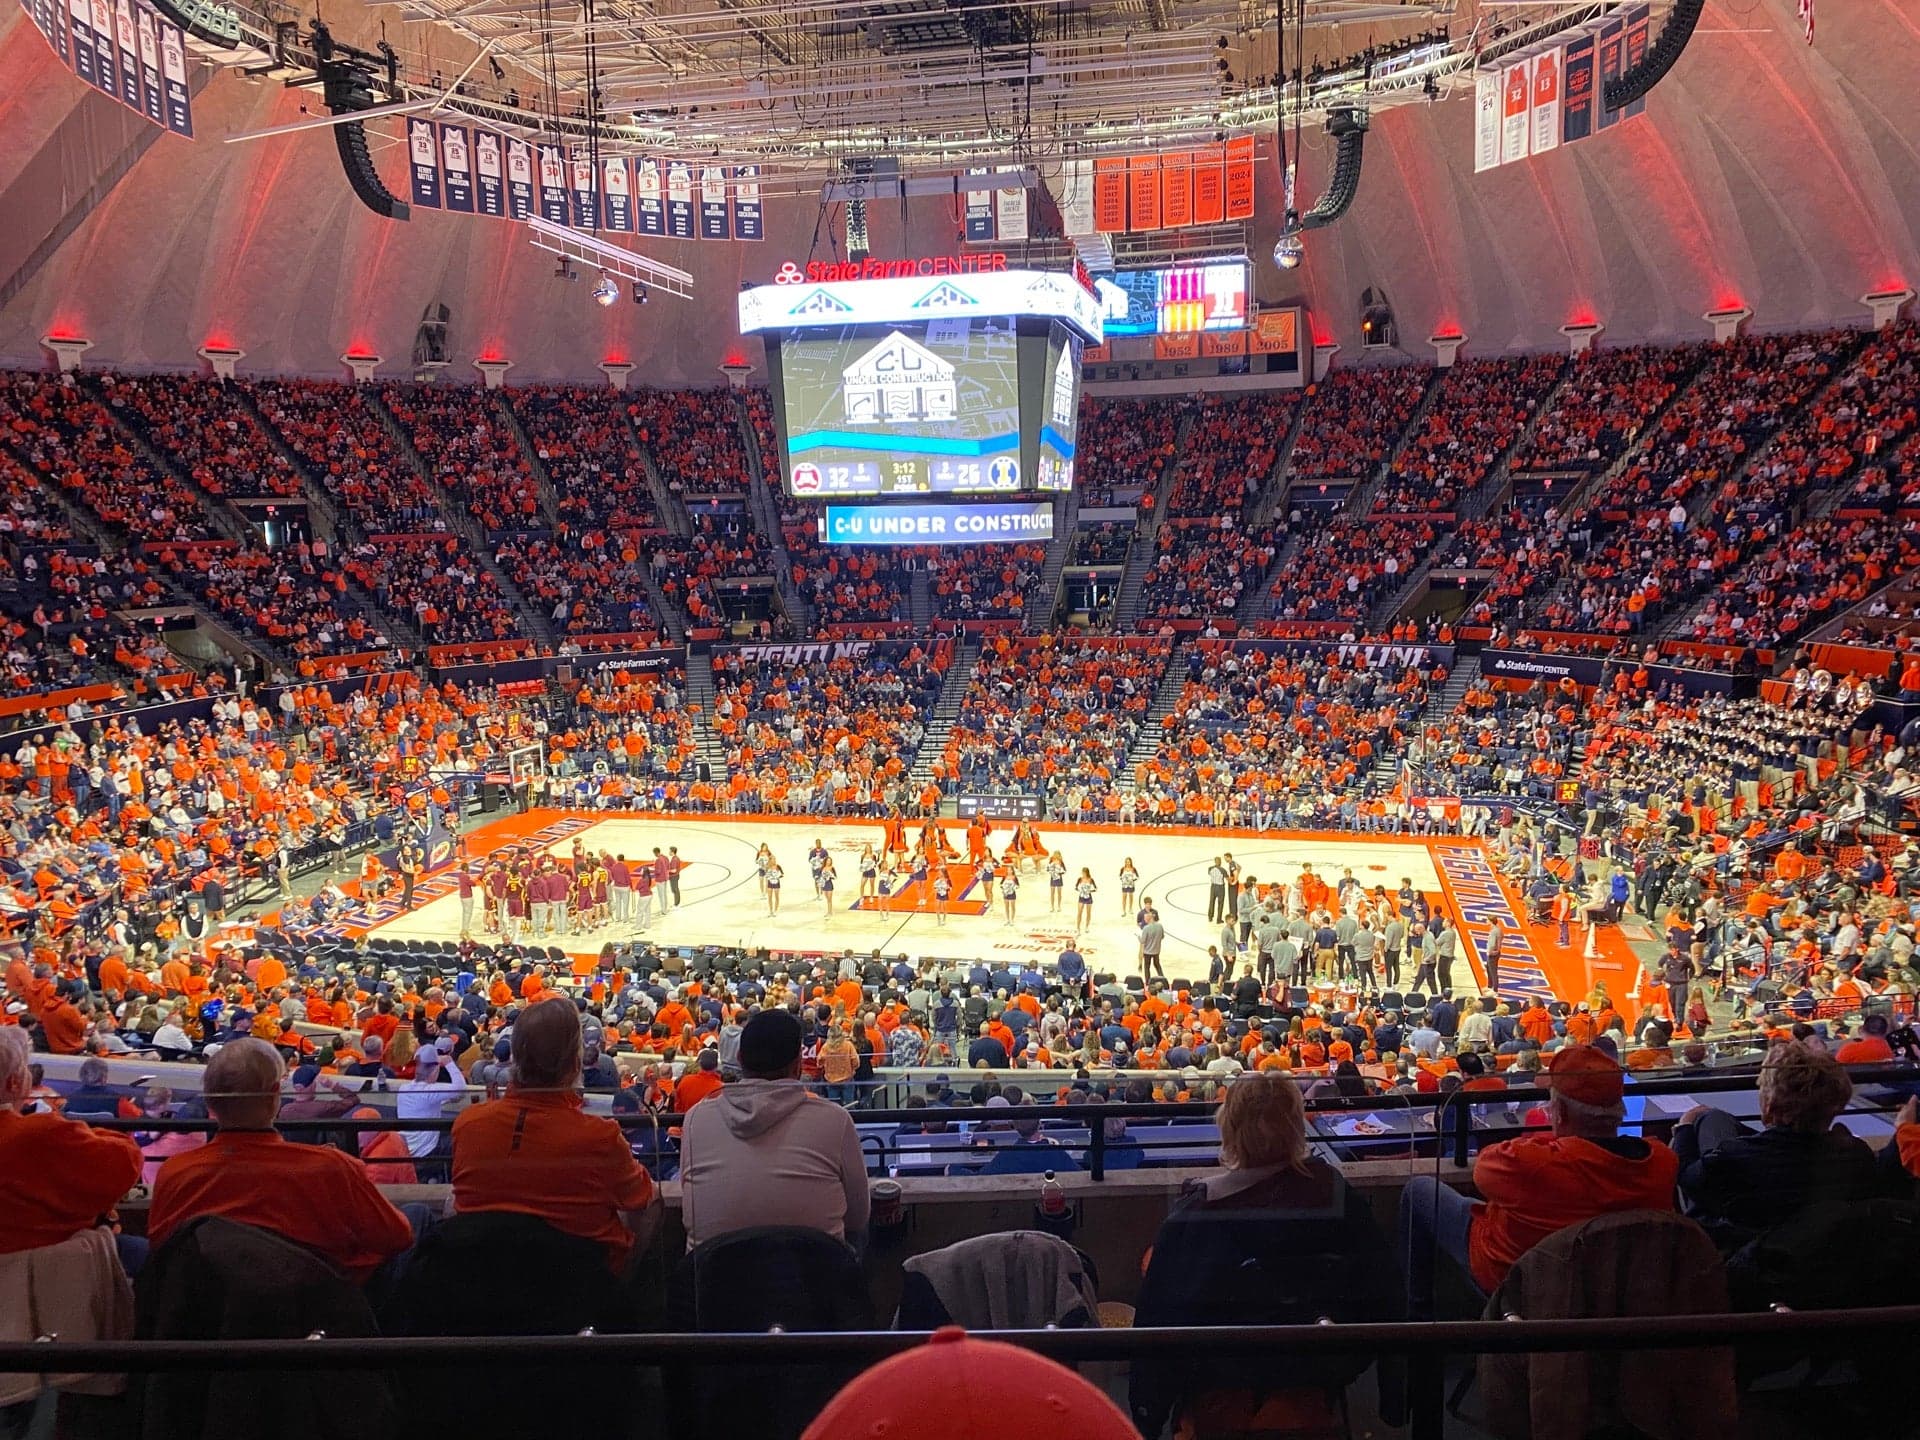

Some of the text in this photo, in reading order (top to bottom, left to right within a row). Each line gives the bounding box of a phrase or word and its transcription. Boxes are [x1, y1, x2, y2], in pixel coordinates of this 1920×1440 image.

[1540, 78, 1551, 92] 13
[1511, 87, 1522, 102] 32
[1483, 98, 1493, 111] 24
[613, 174, 621, 185] 4
[918, 253, 1008, 276] CENTER
[1164, 346, 1192, 357] 1952
[1209, 343, 1239, 354] 1989
[875, 347, 921, 372] C-U
[845, 372, 953, 385] UNDER CONSTRUCTION
[893, 462, 916, 475] 3:12
[957, 464, 981, 485] 26
[828, 467, 849, 489] 32
[835, 517, 862, 535] C-U
[869, 517, 946, 535] UNDER
[740, 642, 870, 665] FIGHTING
[1544, 665, 1570, 675] CENTER
[1562, 791, 1574, 800] 20
[1435, 844, 1521, 930] FIGHTING
[801, 1044, 816, 1059] 24
